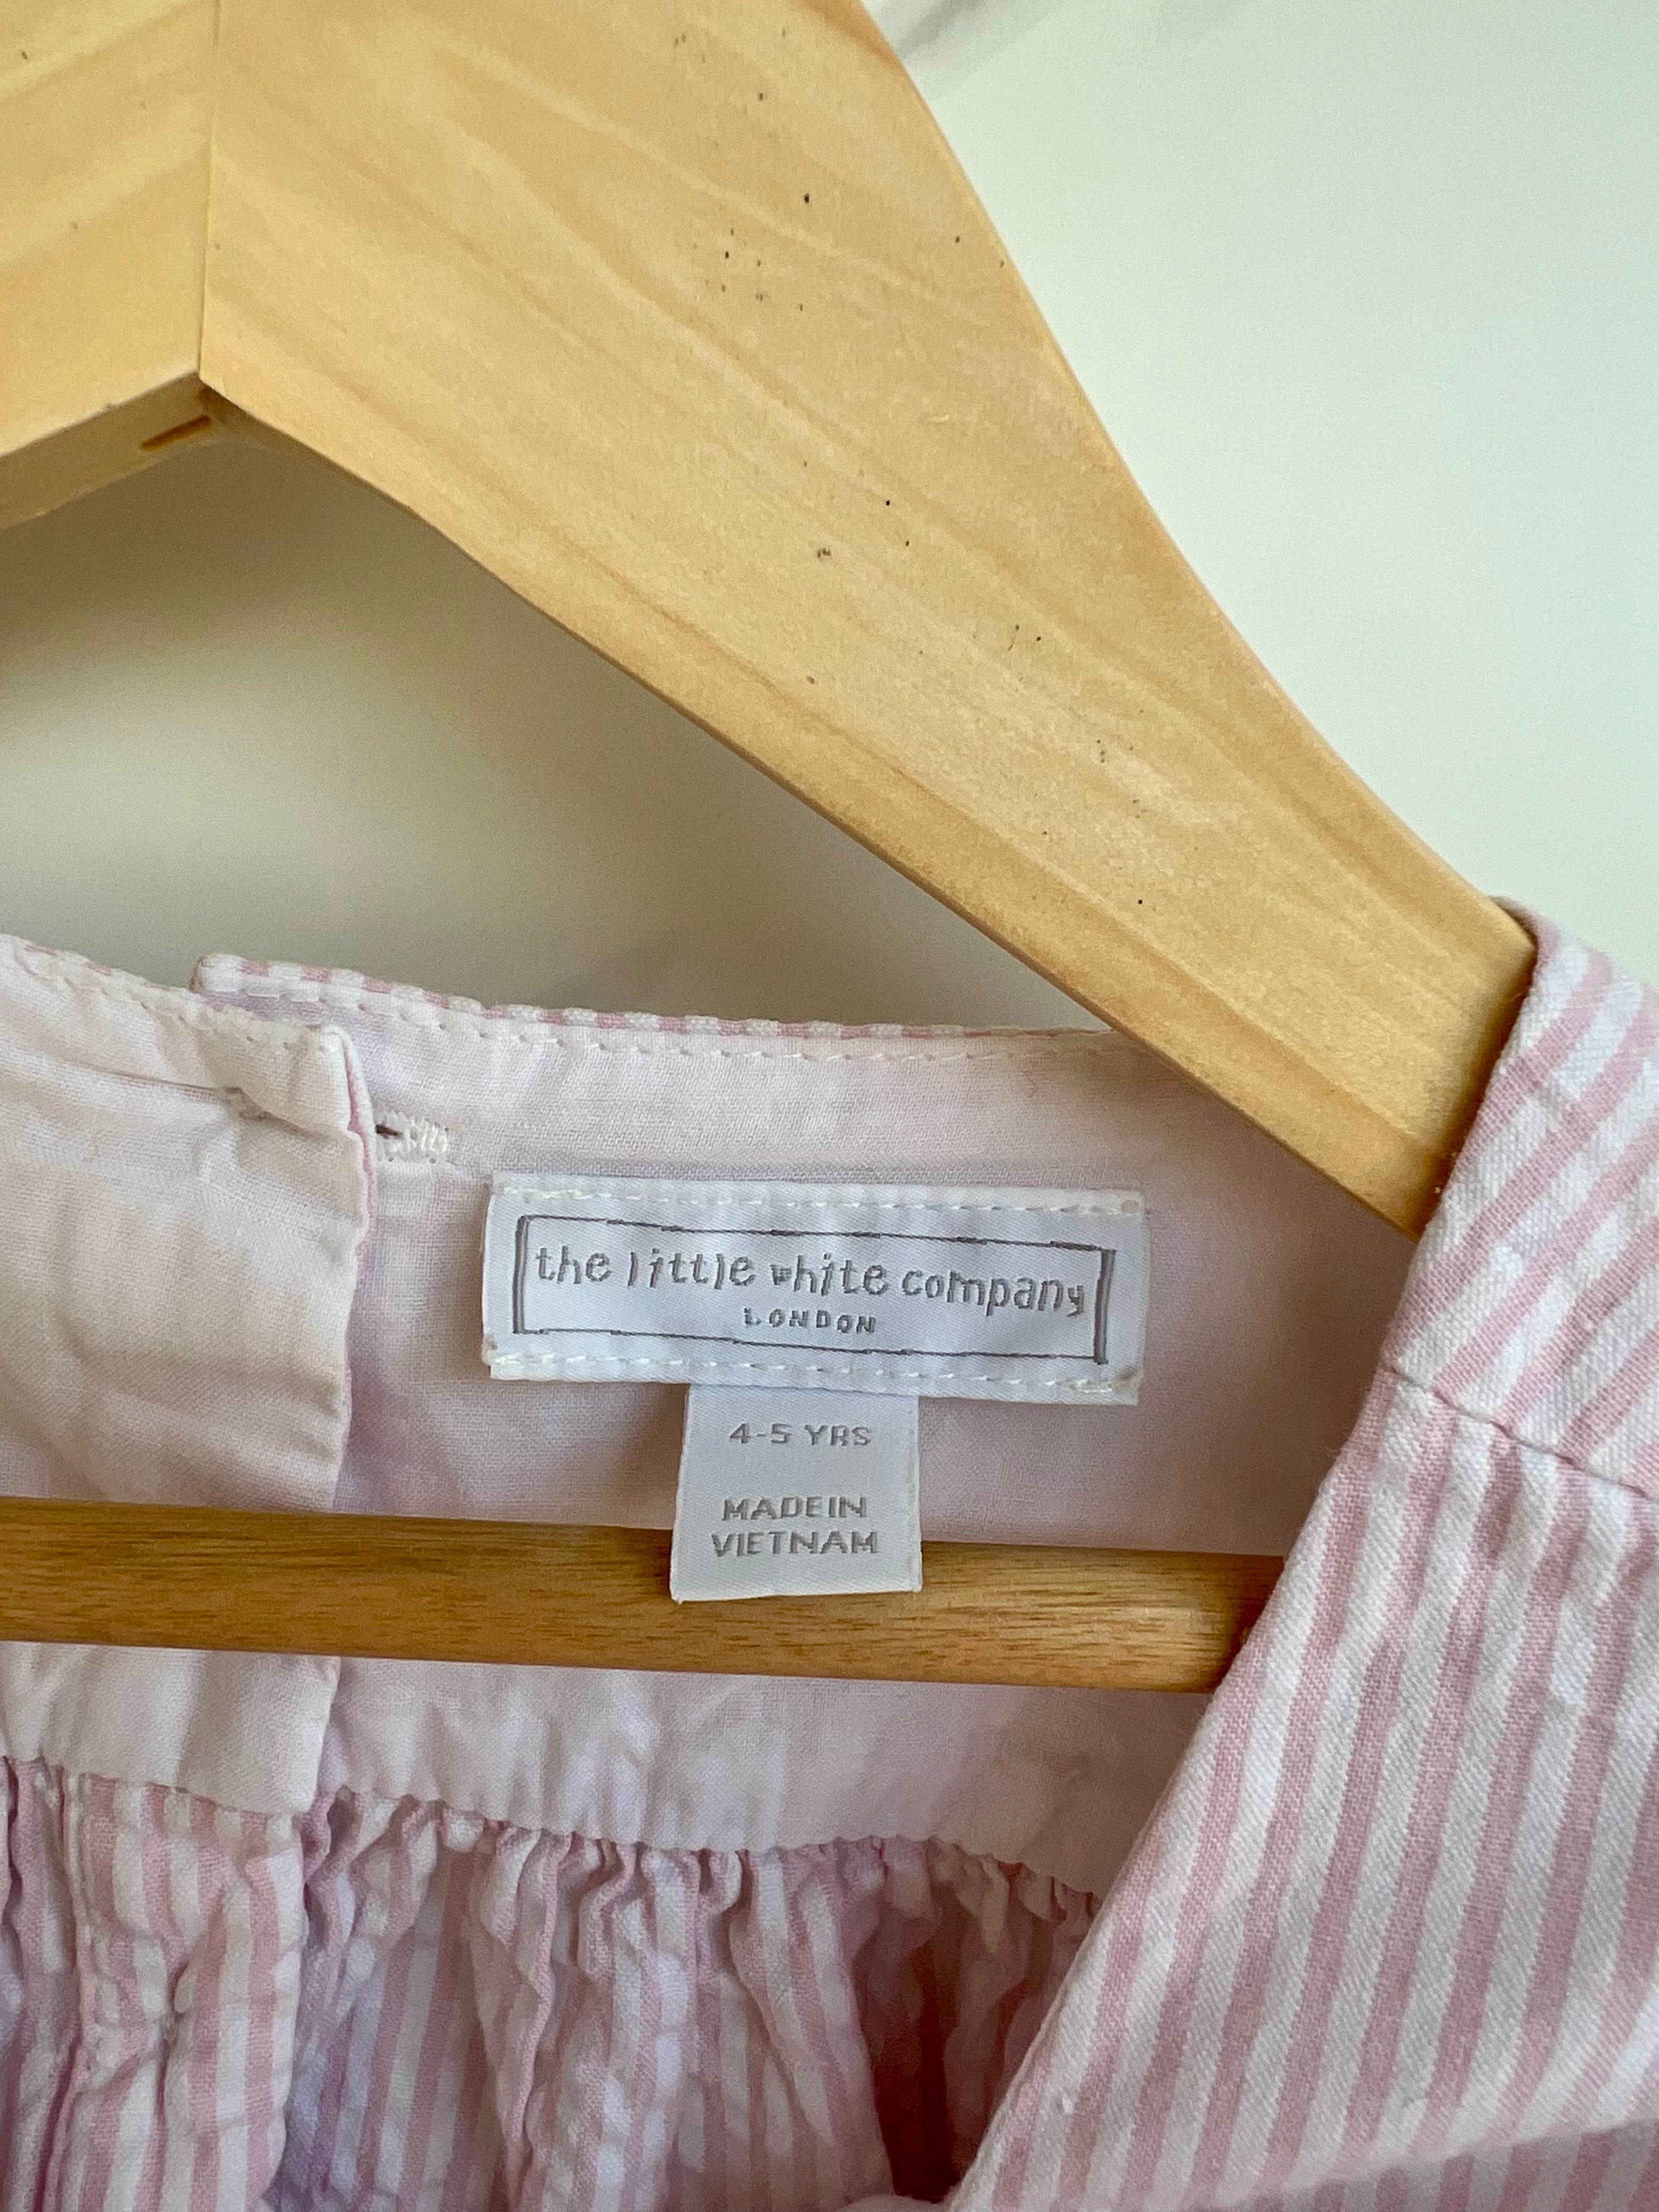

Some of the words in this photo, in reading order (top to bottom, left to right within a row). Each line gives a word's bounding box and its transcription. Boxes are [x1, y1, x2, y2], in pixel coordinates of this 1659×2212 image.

[535, 1245, 611, 1284] the
[627, 1247, 756, 1290] little
[771, 1251, 888, 1296] white
[901, 1265, 1086, 1317] company
[742, 1307, 877, 1335] LONDON
[730, 1423, 792, 1444] 4-5
[805, 1424, 872, 1446] YRS
[721, 1496, 822, 1521] MADE
[828, 1496, 867, 1519] IN
[711, 1530, 878, 1558] VIETNAM
